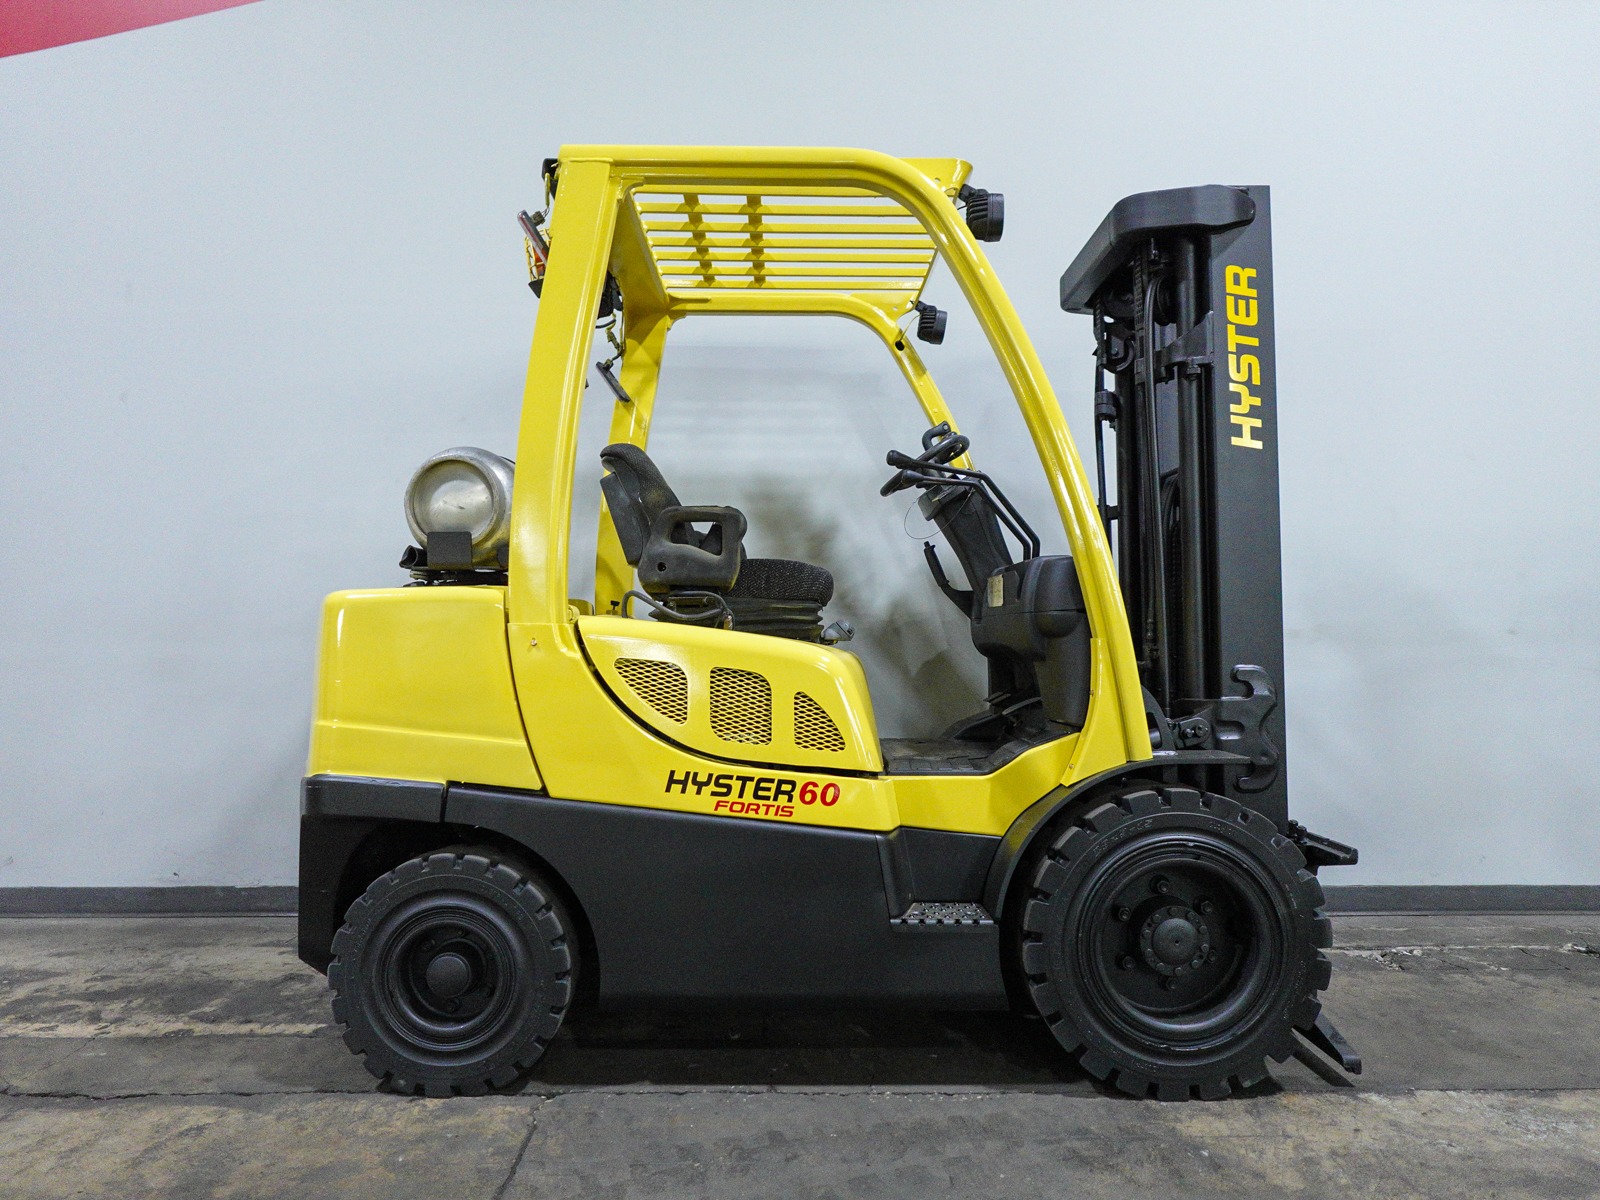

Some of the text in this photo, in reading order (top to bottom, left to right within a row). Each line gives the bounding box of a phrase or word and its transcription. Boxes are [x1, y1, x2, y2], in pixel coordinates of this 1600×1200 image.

[1225, 265, 1263, 449] HYSTER
[664, 769, 841, 807] HYSTER 60
[713, 800, 795, 817] FORTIS
